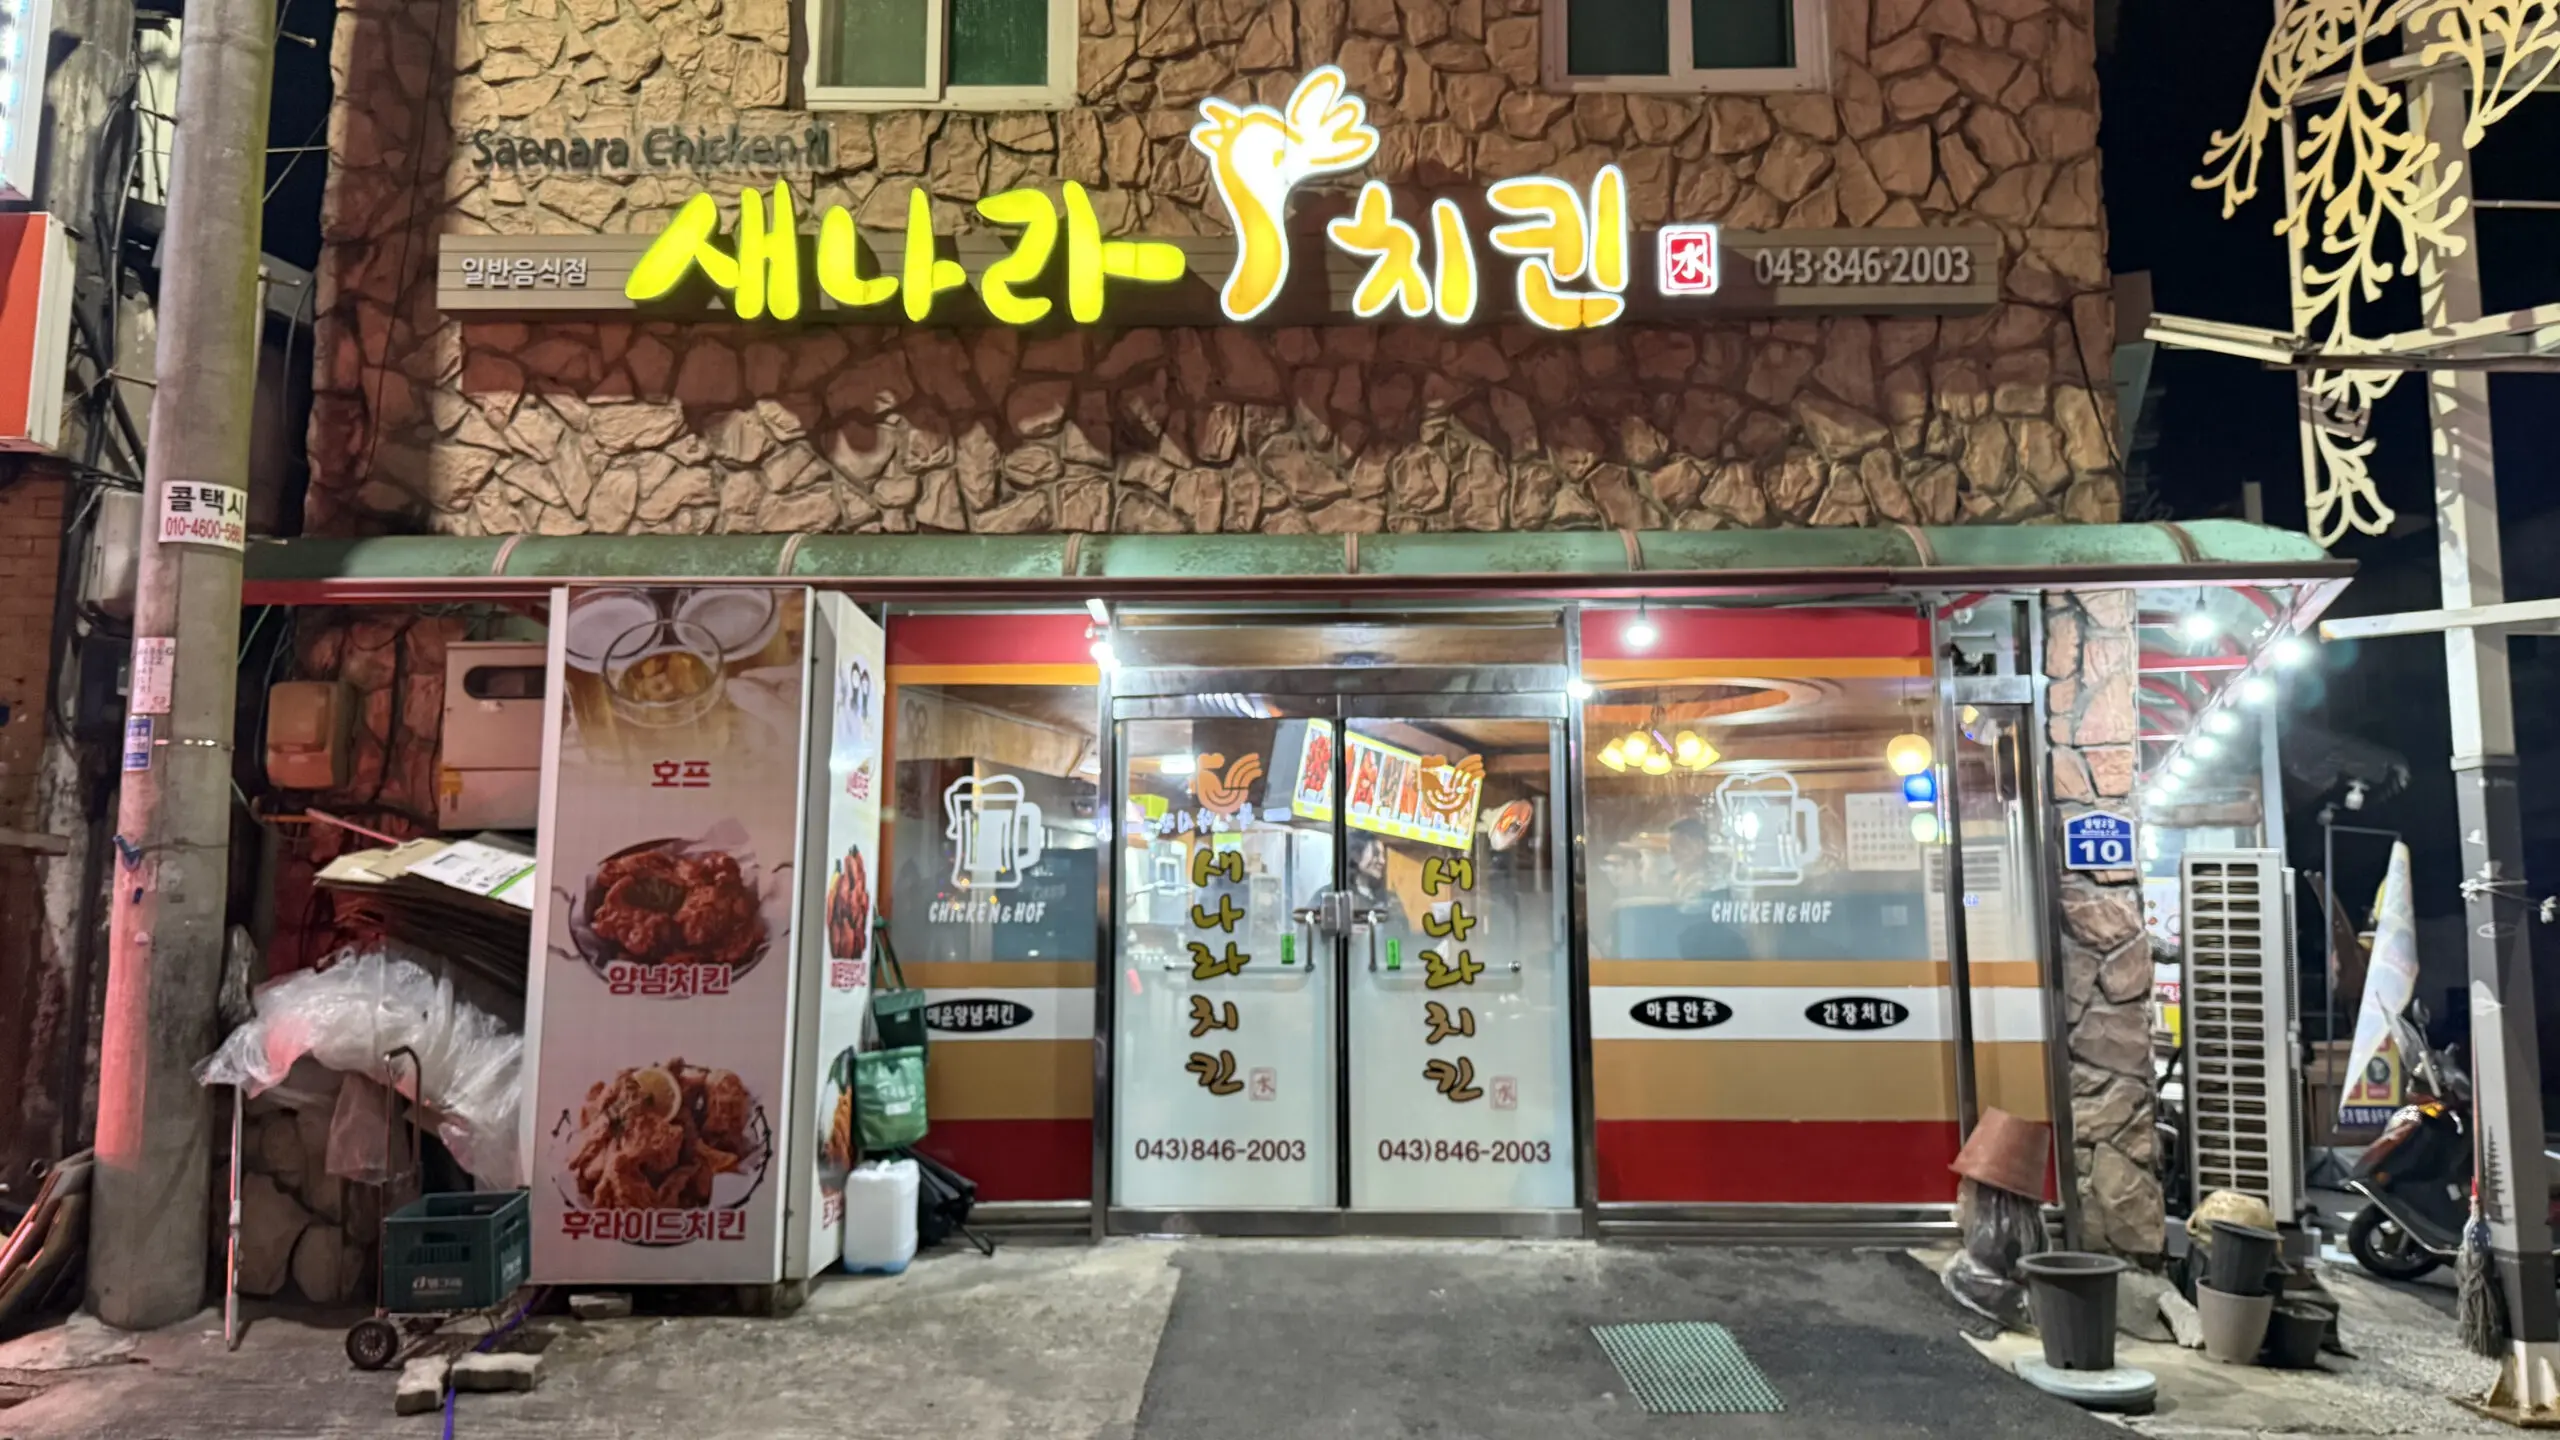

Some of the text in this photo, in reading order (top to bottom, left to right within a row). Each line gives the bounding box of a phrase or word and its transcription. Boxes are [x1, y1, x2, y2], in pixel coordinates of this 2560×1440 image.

[471, 128, 631, 169] Saenara
[625, 163, 1629, 330] 새나라 치킨
[461, 257, 587, 286] 일반음식점
[651, 760, 711, 788] 호프
[2079, 840, 2123, 862] 10
[608, 964, 729, 995] 양념치킨
[1646, 1001, 1719, 1022] 마른안주
[1823, 1003, 1896, 1024] 간장치킨
[1135, 1139, 1306, 1162] 043)846-2003
[1378, 1139, 1552, 1163] 043)846-2003
[562, 1208, 746, 1241] 후라이드치킨
